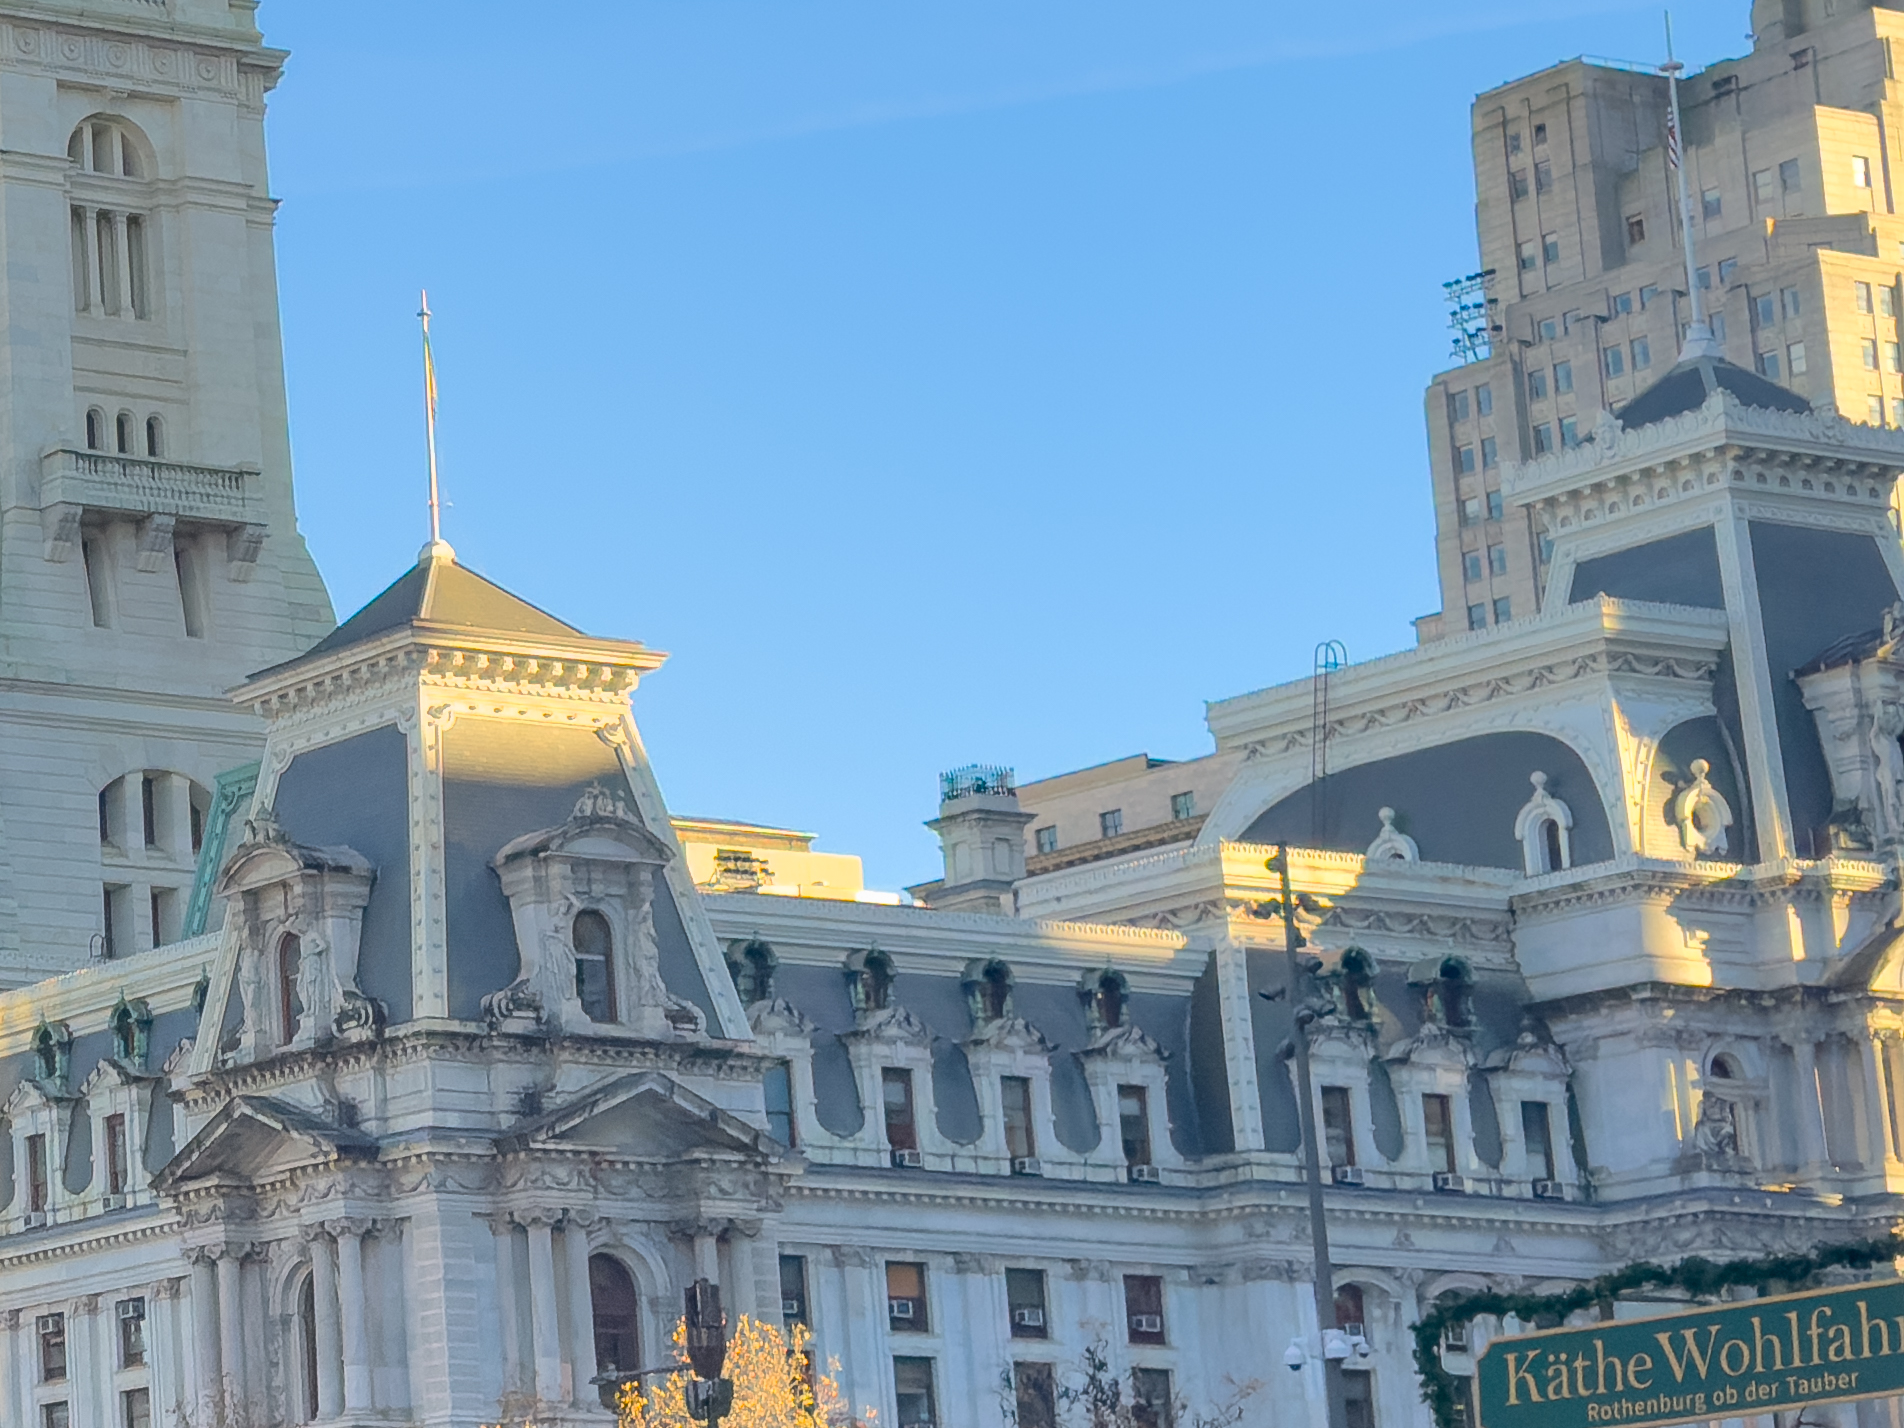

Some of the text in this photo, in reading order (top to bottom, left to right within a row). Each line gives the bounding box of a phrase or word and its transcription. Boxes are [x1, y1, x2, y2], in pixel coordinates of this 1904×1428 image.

[1503, 1337, 1654, 1407] Käthe
[1587, 1370, 1859, 1422] Rothenburg ob der Tauber
